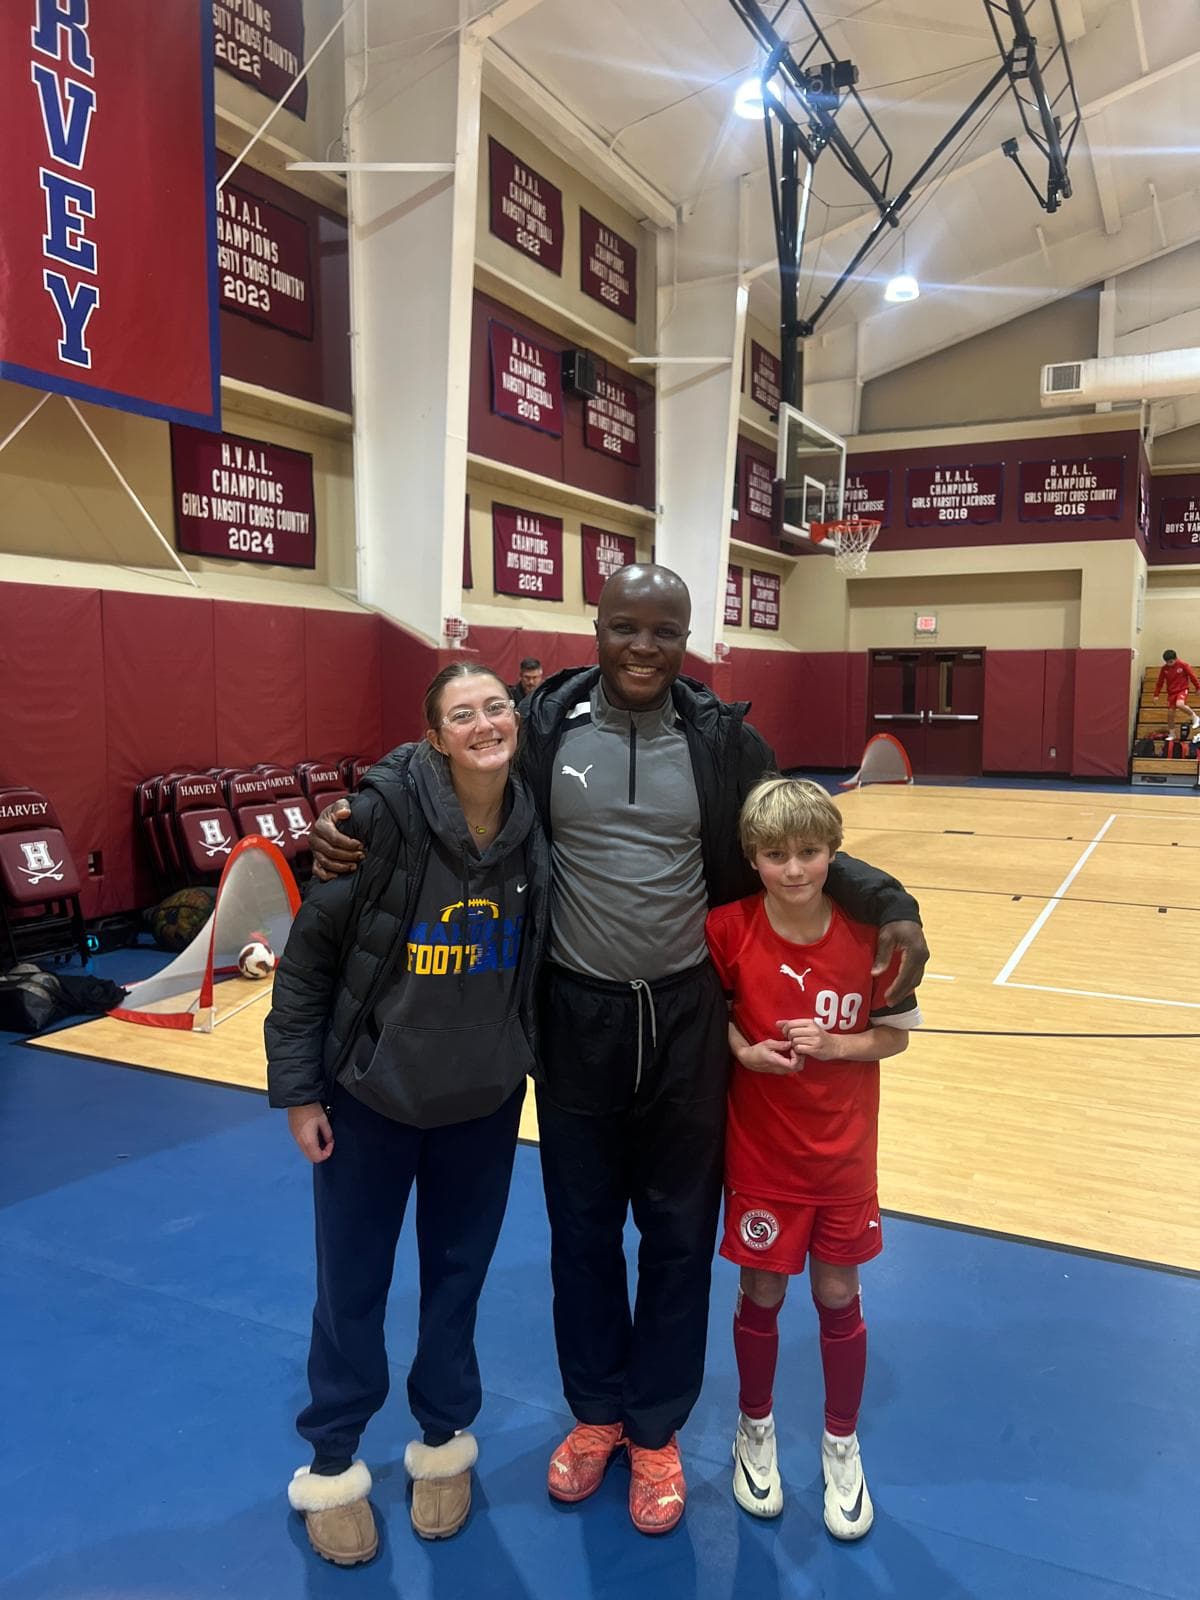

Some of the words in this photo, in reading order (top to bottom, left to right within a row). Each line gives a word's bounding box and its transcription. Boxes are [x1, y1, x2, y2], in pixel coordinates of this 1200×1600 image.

[215, 33, 261, 80] 2022
[510, 181, 547, 222] CHAMPIONS
[243, 255, 269, 287] CROSS
[270, 267, 305, 302] COUNTRY
[224, 276, 271, 312] 2023
[509, 355, 547, 388] CHAMPIONS
[502, 371, 526, 398] VARSITY
[526, 383, 554, 411] BASEBALL
[212, 469, 284, 505] CHAMPIONS
[929, 483, 979, 496] CHAMPIONS
[1044, 476, 1098, 491] CHAMPIONS
[911, 498, 931, 509] GIRLS
[932, 496, 960, 508] VARSITY
[961, 494, 997, 507] LACROSSE
[1024, 491, 1042, 504] GIRLS
[1043, 490, 1068, 503] VARSITY
[1069, 489, 1089, 502] CROSS
[1089, 487, 1118, 501] COUNTRY
[182, 492, 209, 519] GIRLS
[211, 497, 247, 525] VARSITY
[249, 504, 275, 529] CROSS
[277, 509, 310, 535] COUNTRY
[853, 500, 885, 512] LACROSSE
[1053, 502, 1087, 516] 2016
[1165, 522, 1185, 534] BOYS
[228, 527, 275, 555] 2024
[511, 533, 549, 556] CHAMPIONS
[596, 546, 625, 566] CHAMPIONS
[518, 573, 544, 592] 2024
[235, 780, 269, 794] HARVEY
[310, 771, 339, 783] HARVEY
[181, 783, 218, 797] HARVEY
[813, 989, 864, 1031] 99
